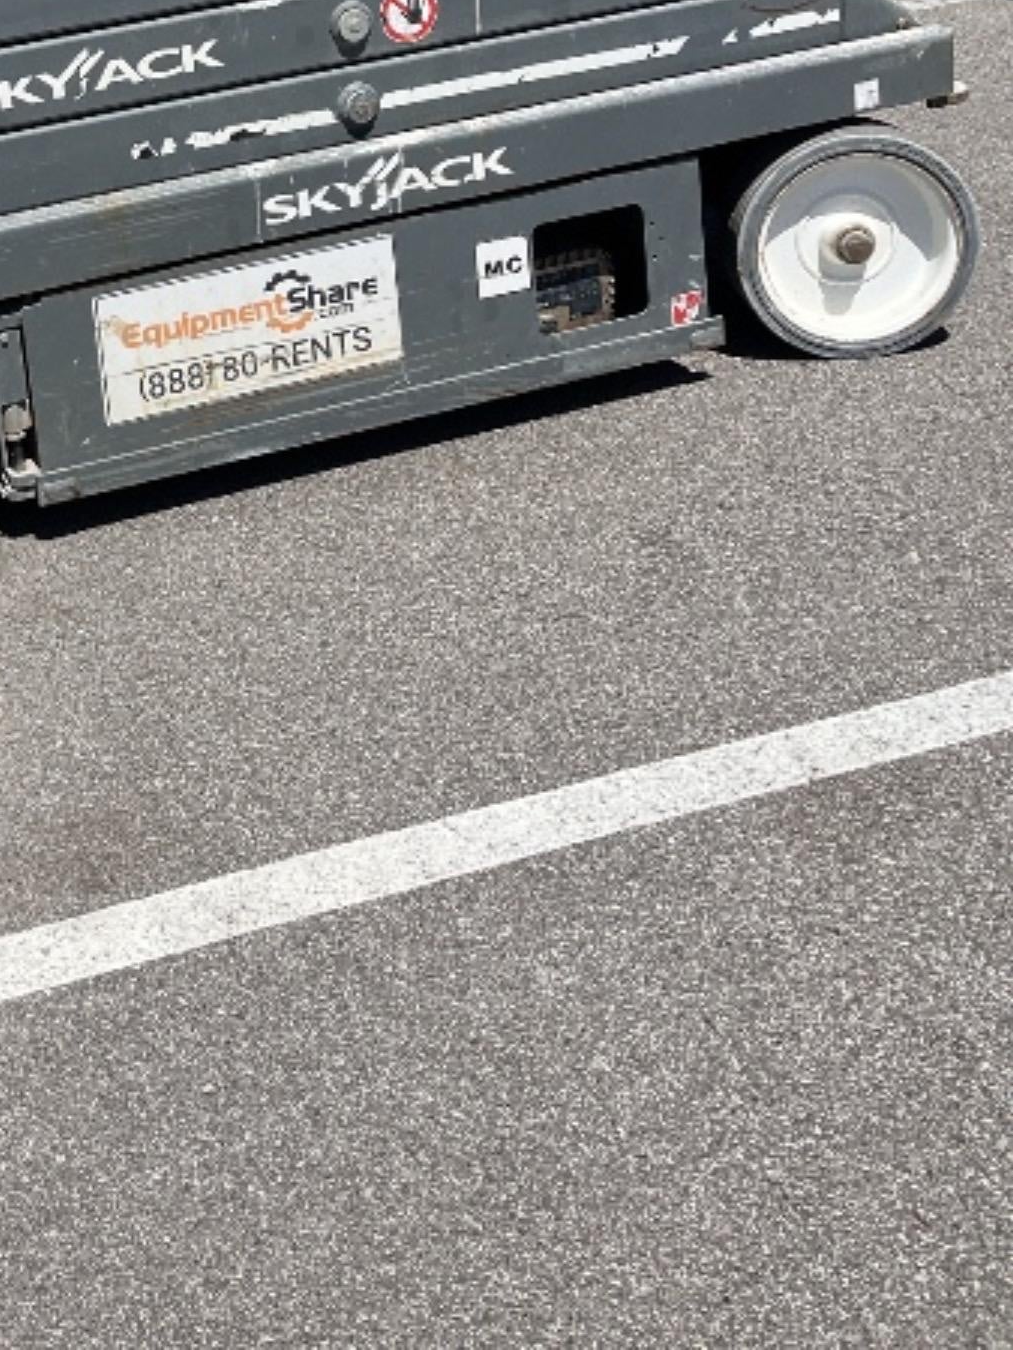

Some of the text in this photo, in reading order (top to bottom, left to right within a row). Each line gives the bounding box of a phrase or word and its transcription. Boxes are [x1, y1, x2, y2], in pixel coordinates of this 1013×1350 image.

[263, 147, 514, 227] SKYJACK
[484, 255, 523, 276] MC
[121, 277, 379, 350] EquipmentShare
